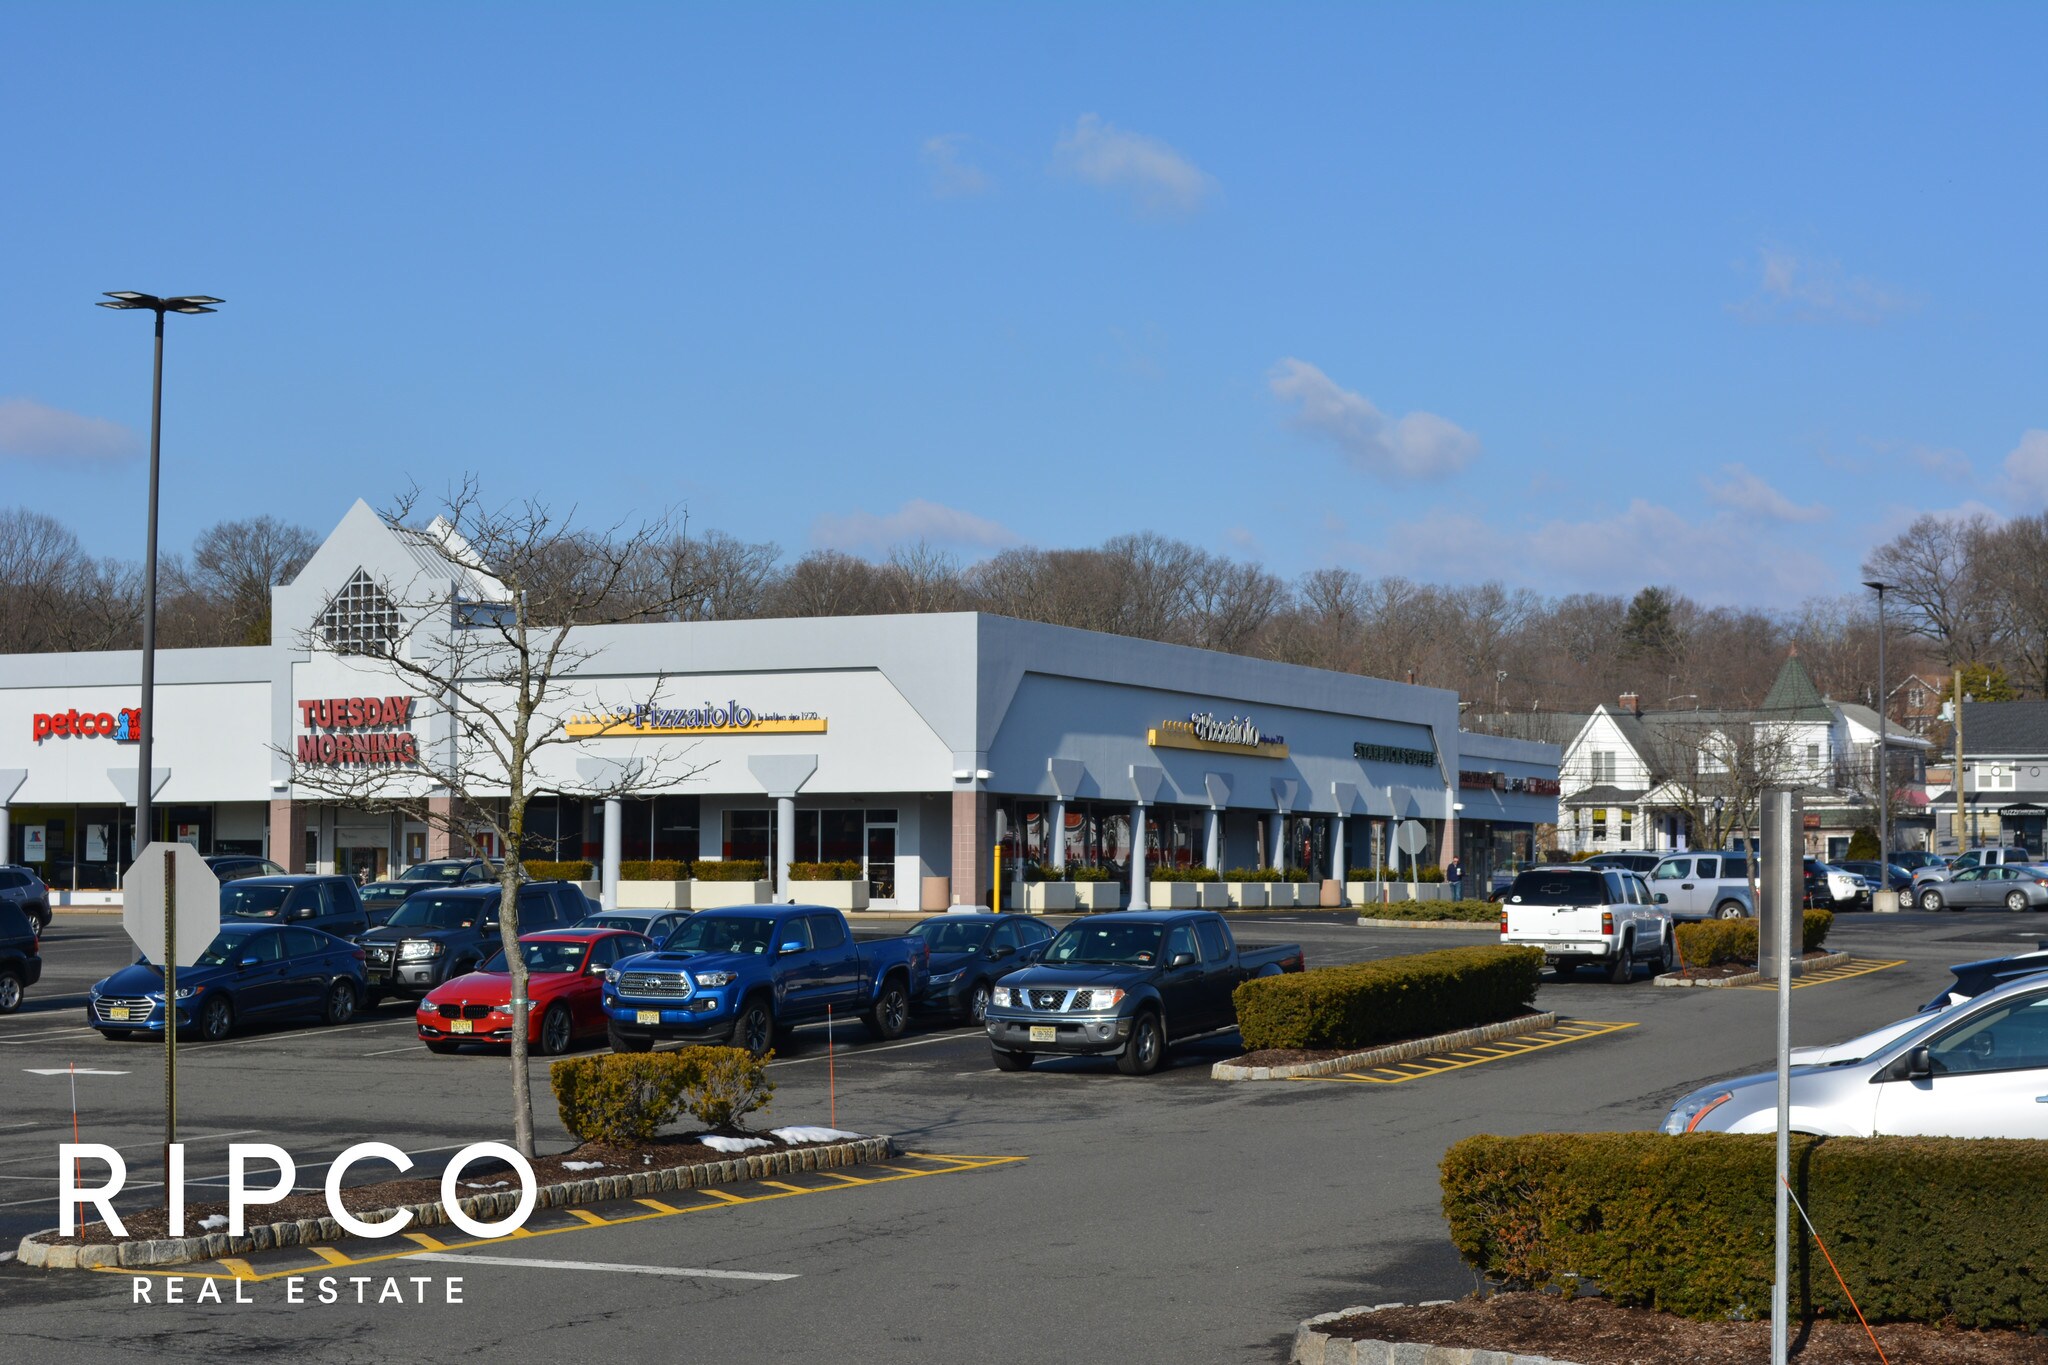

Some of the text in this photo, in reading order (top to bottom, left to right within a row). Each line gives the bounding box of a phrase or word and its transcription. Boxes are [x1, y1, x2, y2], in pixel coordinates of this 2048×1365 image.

[33, 708, 116, 742] petco
[298, 696, 413, 729] TUESDAY
[617, 700, 752, 729] Pizzaiolo
[298, 732, 418, 764] MORNING
